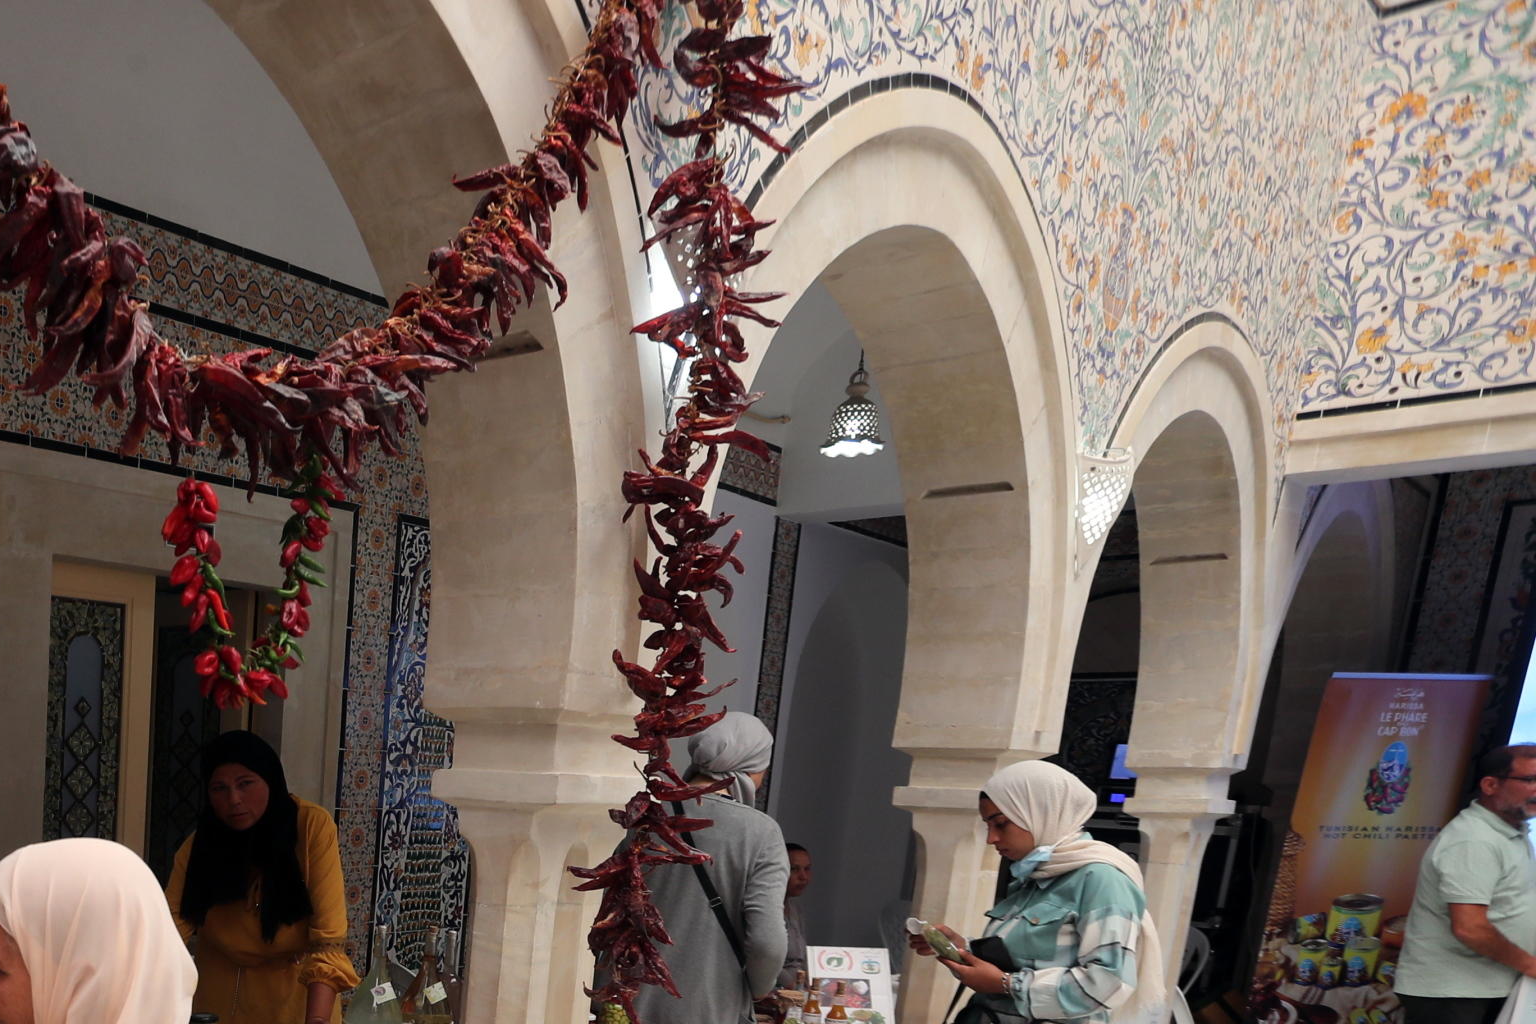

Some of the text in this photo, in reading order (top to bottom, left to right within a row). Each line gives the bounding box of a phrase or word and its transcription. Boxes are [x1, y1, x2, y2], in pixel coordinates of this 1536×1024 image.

[1380, 713, 1393, 722] LE
[1377, 727, 1397, 736] CAP
[1319, 825, 1381, 833] TUNISIAN
